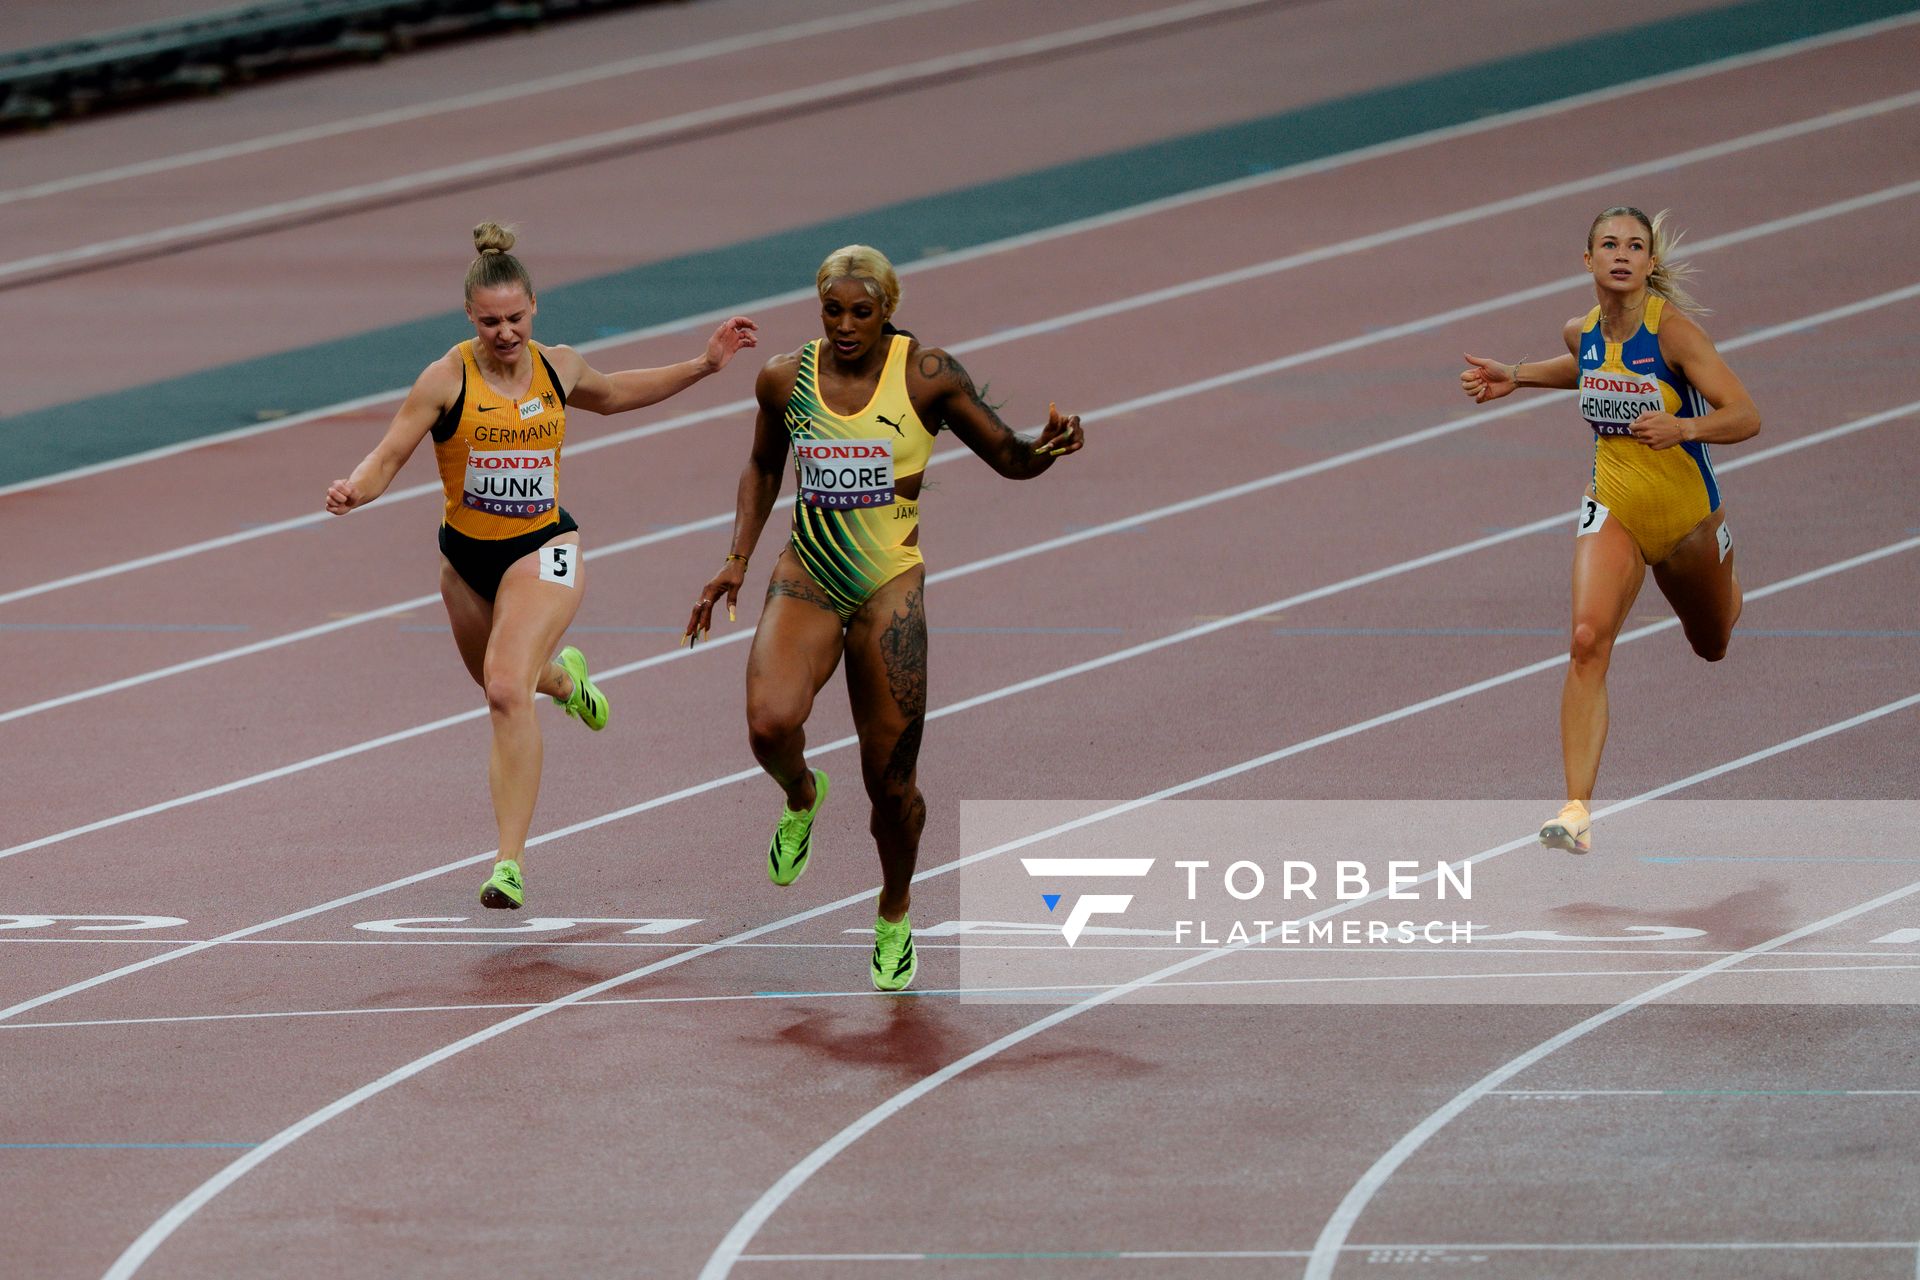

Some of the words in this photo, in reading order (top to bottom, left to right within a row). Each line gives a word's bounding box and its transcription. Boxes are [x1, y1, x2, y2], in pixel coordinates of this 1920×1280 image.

[1583, 376, 1657, 394] HONDA
[520, 402, 542, 417] WGV
[1582, 397, 1661, 420] HENRIKSSON
[475, 420, 559, 443] GERMANY
[468, 456, 553, 469] HONDA
[797, 446, 890, 459] HONDA
[474, 476, 543, 498] JUNK
[806, 467, 888, 489] MOORE
[1583, 501, 1597, 529] 3
[553, 548, 568, 577] 5
[354, 917, 704, 934] 5
